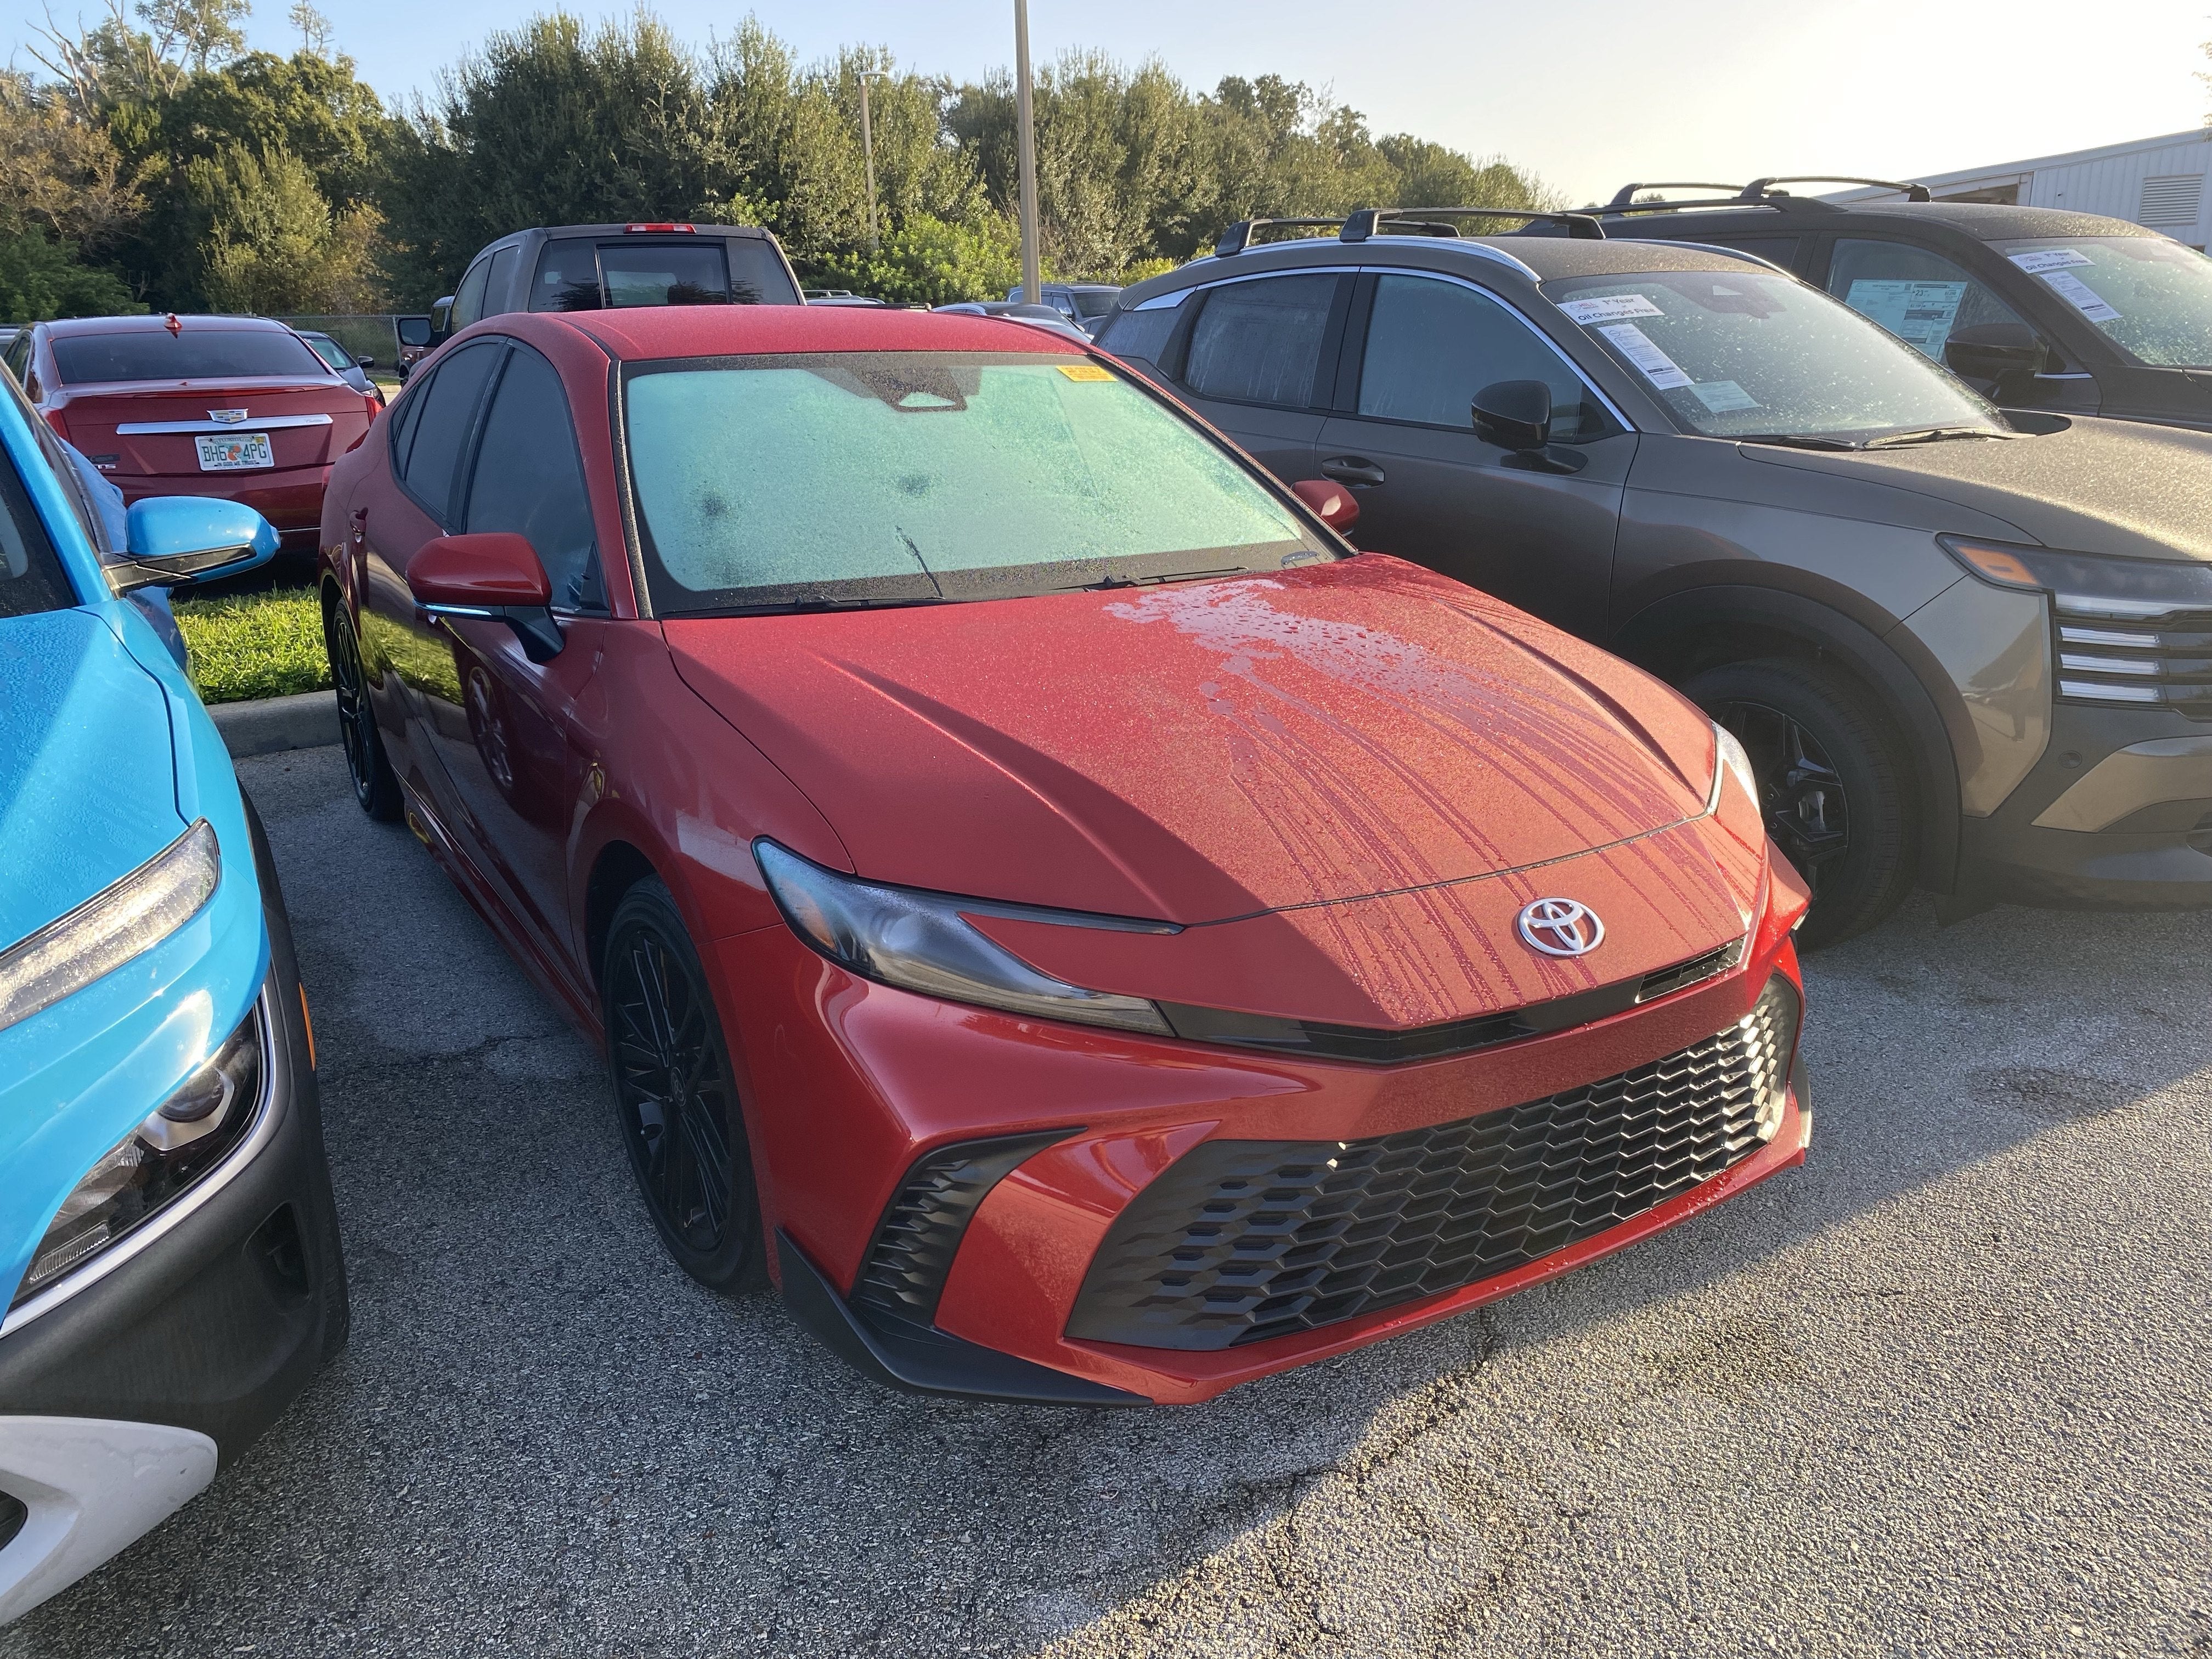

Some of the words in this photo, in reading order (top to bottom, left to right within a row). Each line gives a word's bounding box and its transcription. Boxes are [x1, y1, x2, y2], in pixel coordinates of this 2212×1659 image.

[1593, 309, 1634, 319] Changes
[201, 445, 227, 462] BH6
[243, 443, 267, 460] 4PG
